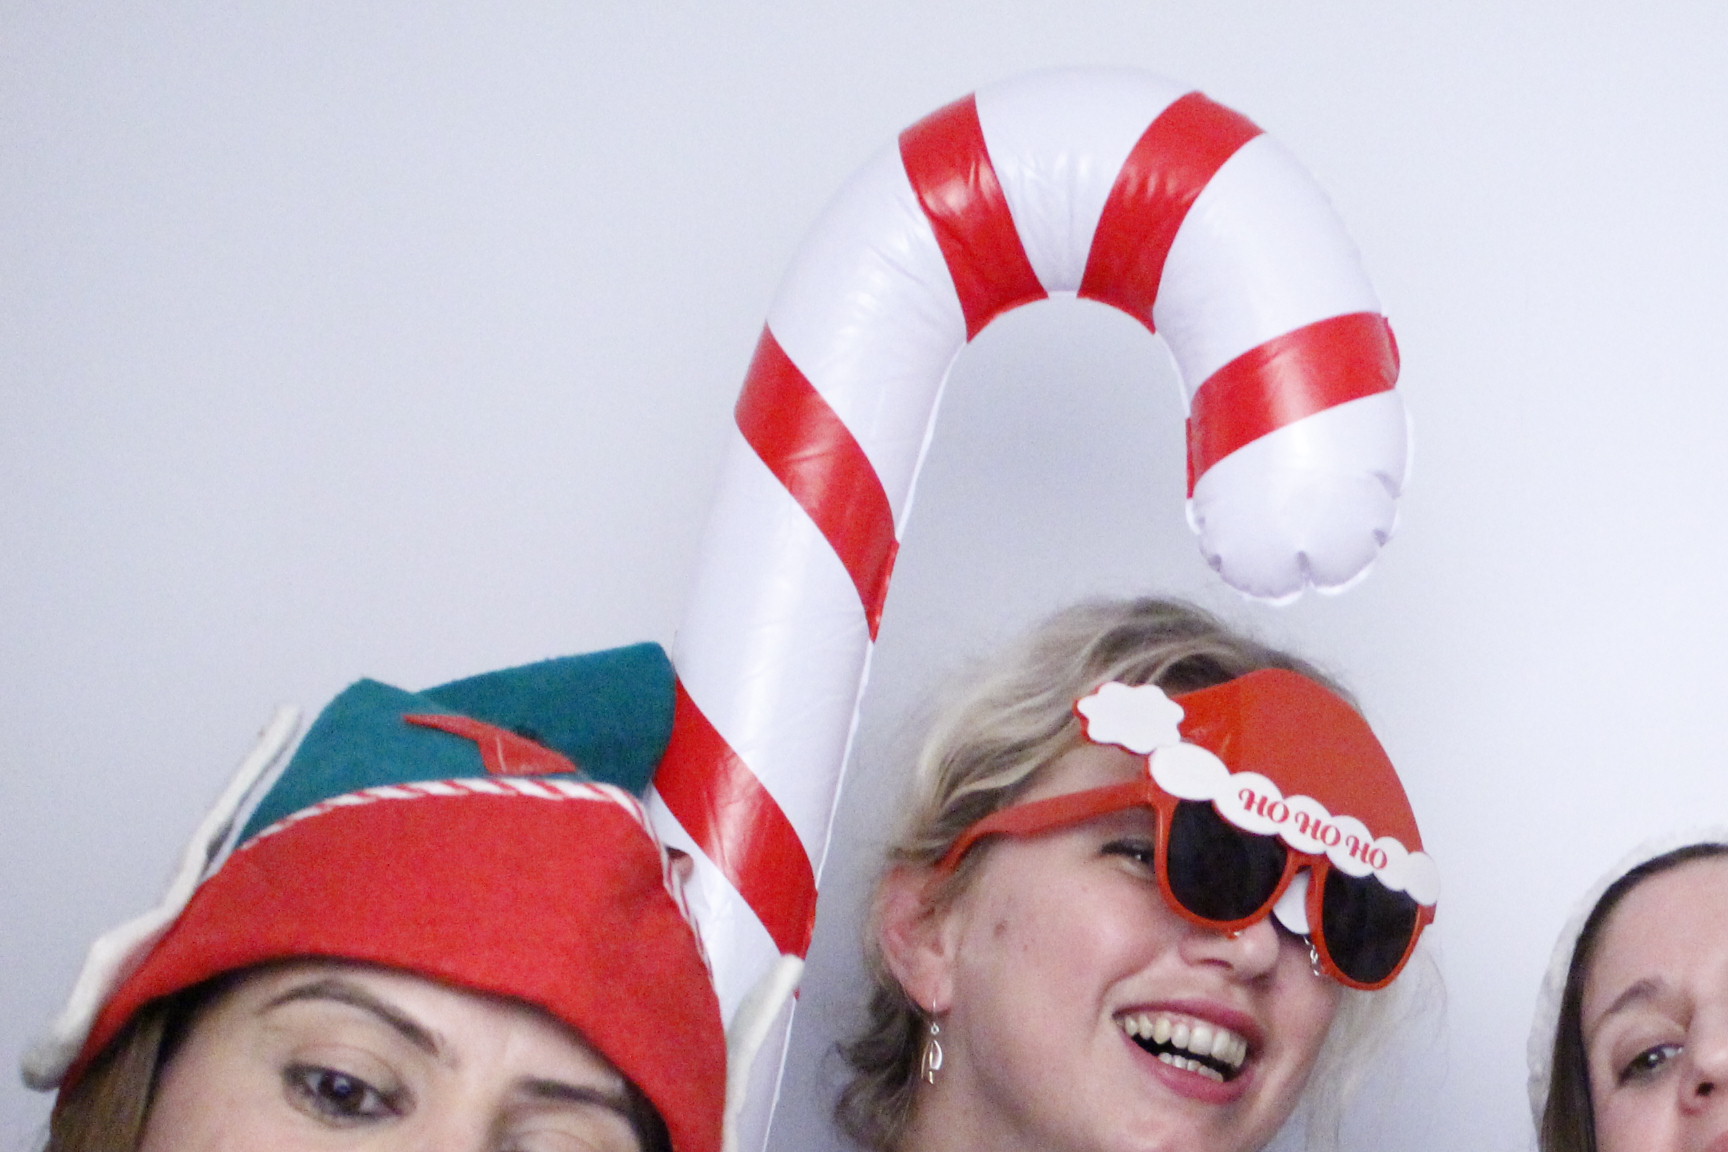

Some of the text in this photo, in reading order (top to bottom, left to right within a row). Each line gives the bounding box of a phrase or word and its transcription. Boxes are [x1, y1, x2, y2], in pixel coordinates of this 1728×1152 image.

[1238, 788, 1388, 869] HO HO HO
